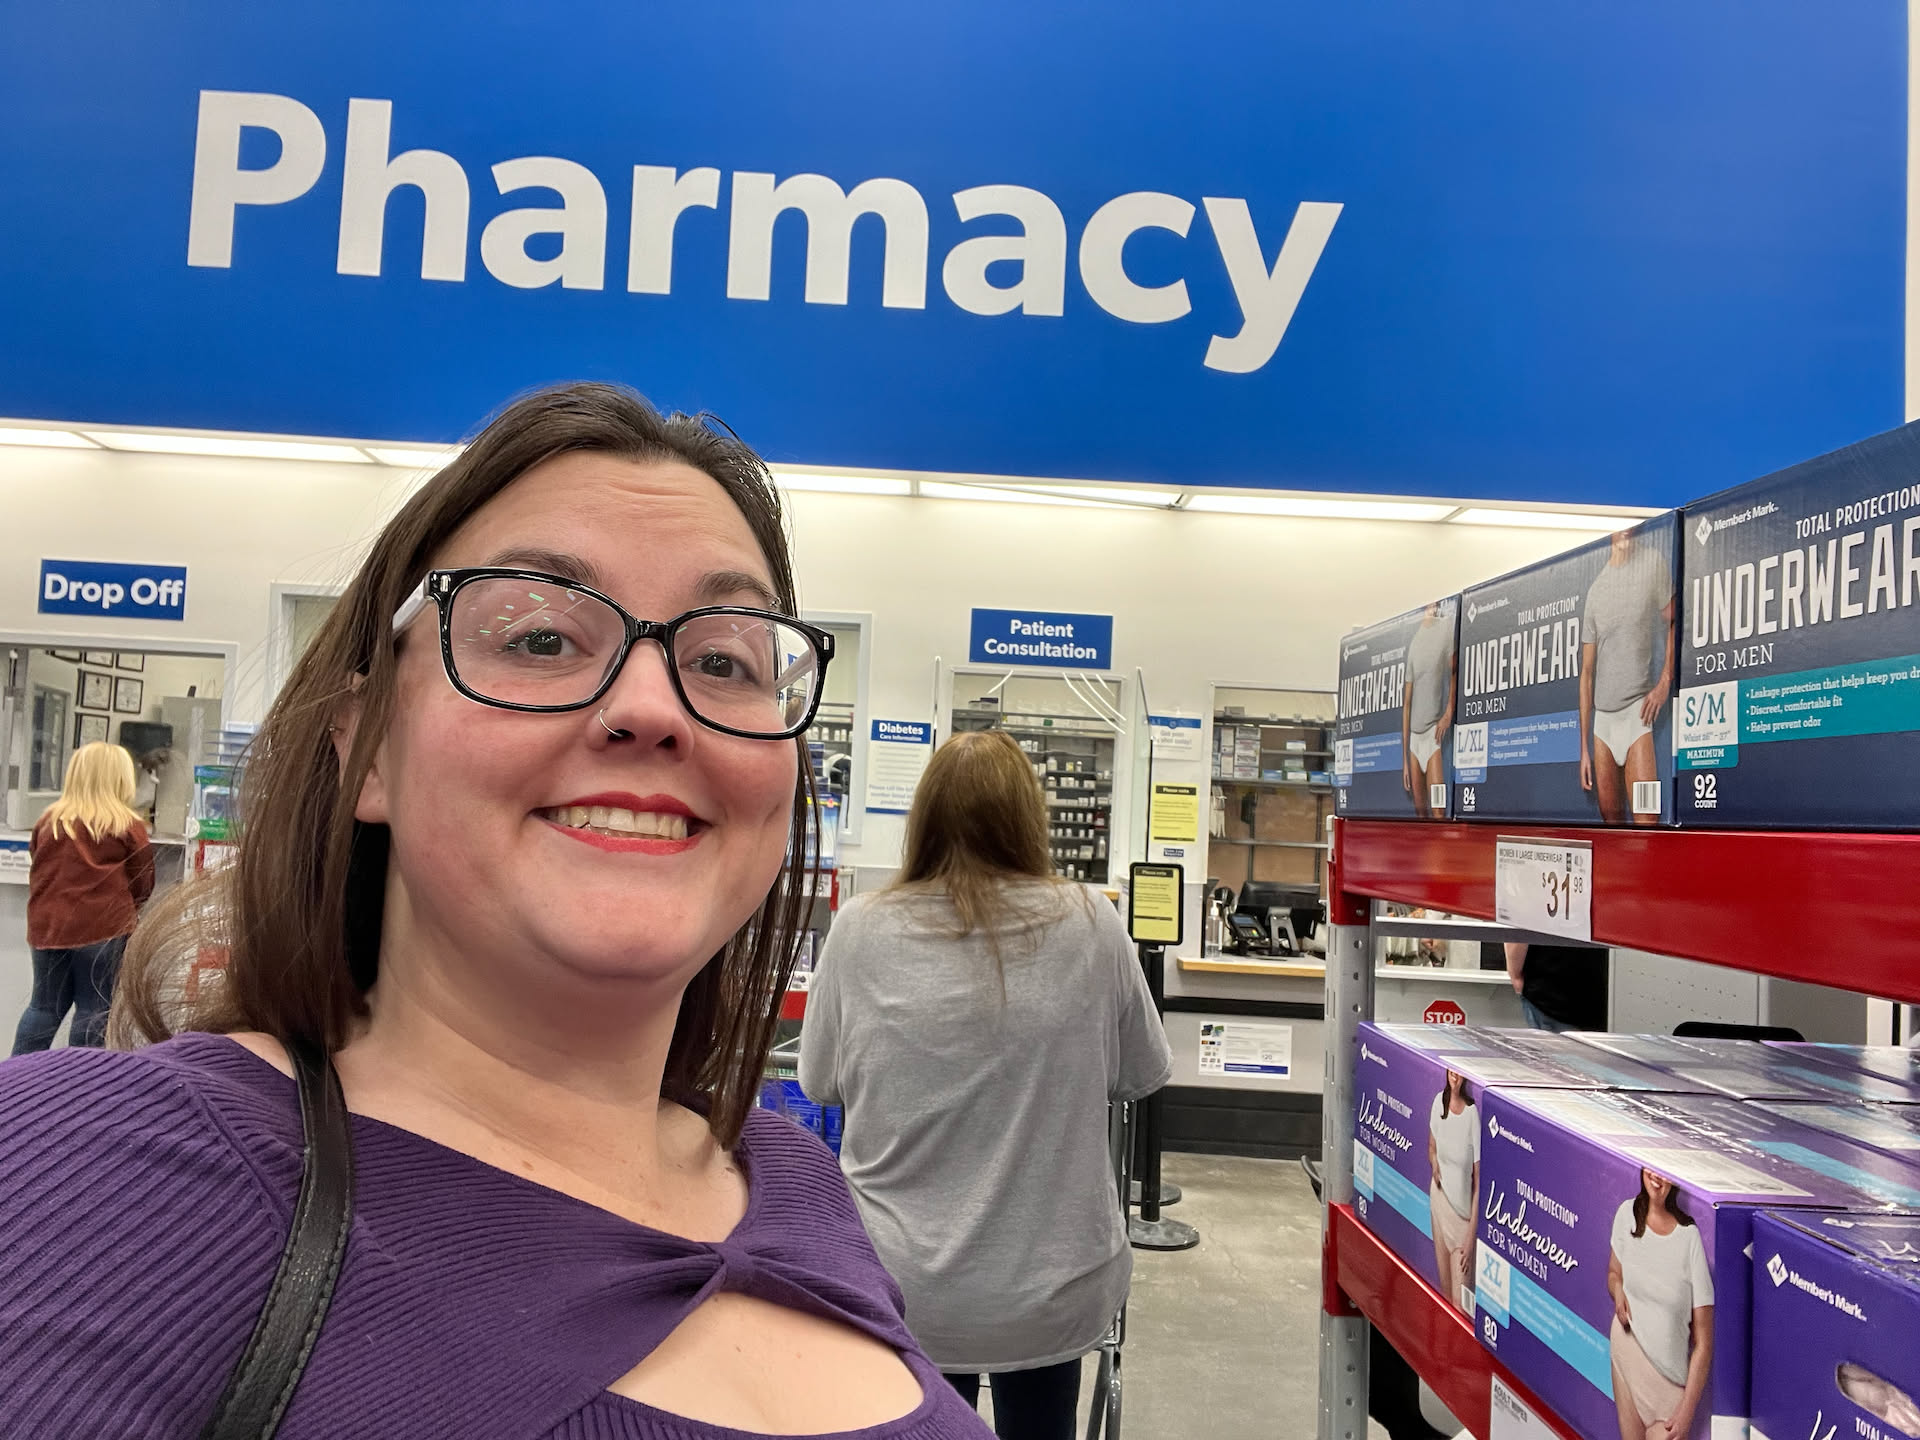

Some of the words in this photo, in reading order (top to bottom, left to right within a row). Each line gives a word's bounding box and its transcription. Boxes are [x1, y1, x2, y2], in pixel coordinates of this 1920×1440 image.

[187, 89, 1344, 374] Pharmacy
[1713, 510, 1751, 532] Member's
[1795, 513, 1832, 540] TOTAL
[1835, 484, 1920, 529] PROTECTION
[44, 573, 125, 609] Drop
[130, 578, 185, 607] Off
[1692, 516, 1920, 649] UNDERWEAR
[1010, 619, 1074, 638] Patient
[1518, 608, 1535, 626] TOTAL
[983, 638, 1097, 660] Consultation
[1464, 617, 1580, 697] UNDERWEAR
[1695, 654, 1728, 676] FOR
[1732, 643, 1774, 670] MEN
[1340, 662, 1406, 719] UNDERWEAR
[1750, 687, 1780, 699] Leakage
[1780, 682, 1822, 697] protection
[1823, 677, 1841, 690] that
[1841, 675, 1865, 689] helps
[1866, 671, 1889, 686] keep
[1889, 671, 1909, 684] you
[1465, 700, 1483, 716] FOR
[1485, 697, 1507, 714] MEN
[1685, 692, 1726, 728] S/M
[1784, 696, 1831, 712] comfortable
[1832, 694, 1843, 707] fit
[878, 722, 924, 735] Diabetes
[1750, 721, 1771, 733] Helps
[1772, 719, 1802, 732] prevent
[1803, 716, 1822, 728] odor
[1457, 728, 1485, 753] L/XL
[1687, 748, 1725, 759] MAXIMUM
[1463, 787, 1476, 805] 84
[1694, 774, 1717, 799] 92
[1694, 799, 1718, 809] COUNT
[1425, 1011, 1463, 1024] STOP
[1358, 1092, 1413, 1153] Underwear
[1359, 1125, 1371, 1146] FOR
[1371, 1132, 1397, 1163] WOMEN
[1358, 1147, 1370, 1173] XL
[1516, 1178, 1535, 1203] TOTAL
[1485, 1180, 1579, 1274] Underwear
[1487, 1224, 1506, 1251] FOR
[1508, 1238, 1548, 1282] WOMEN
[1482, 1252, 1503, 1289] XL
[1789, 1270, 1835, 1305] Member's
[1483, 1315, 1498, 1342] 80
